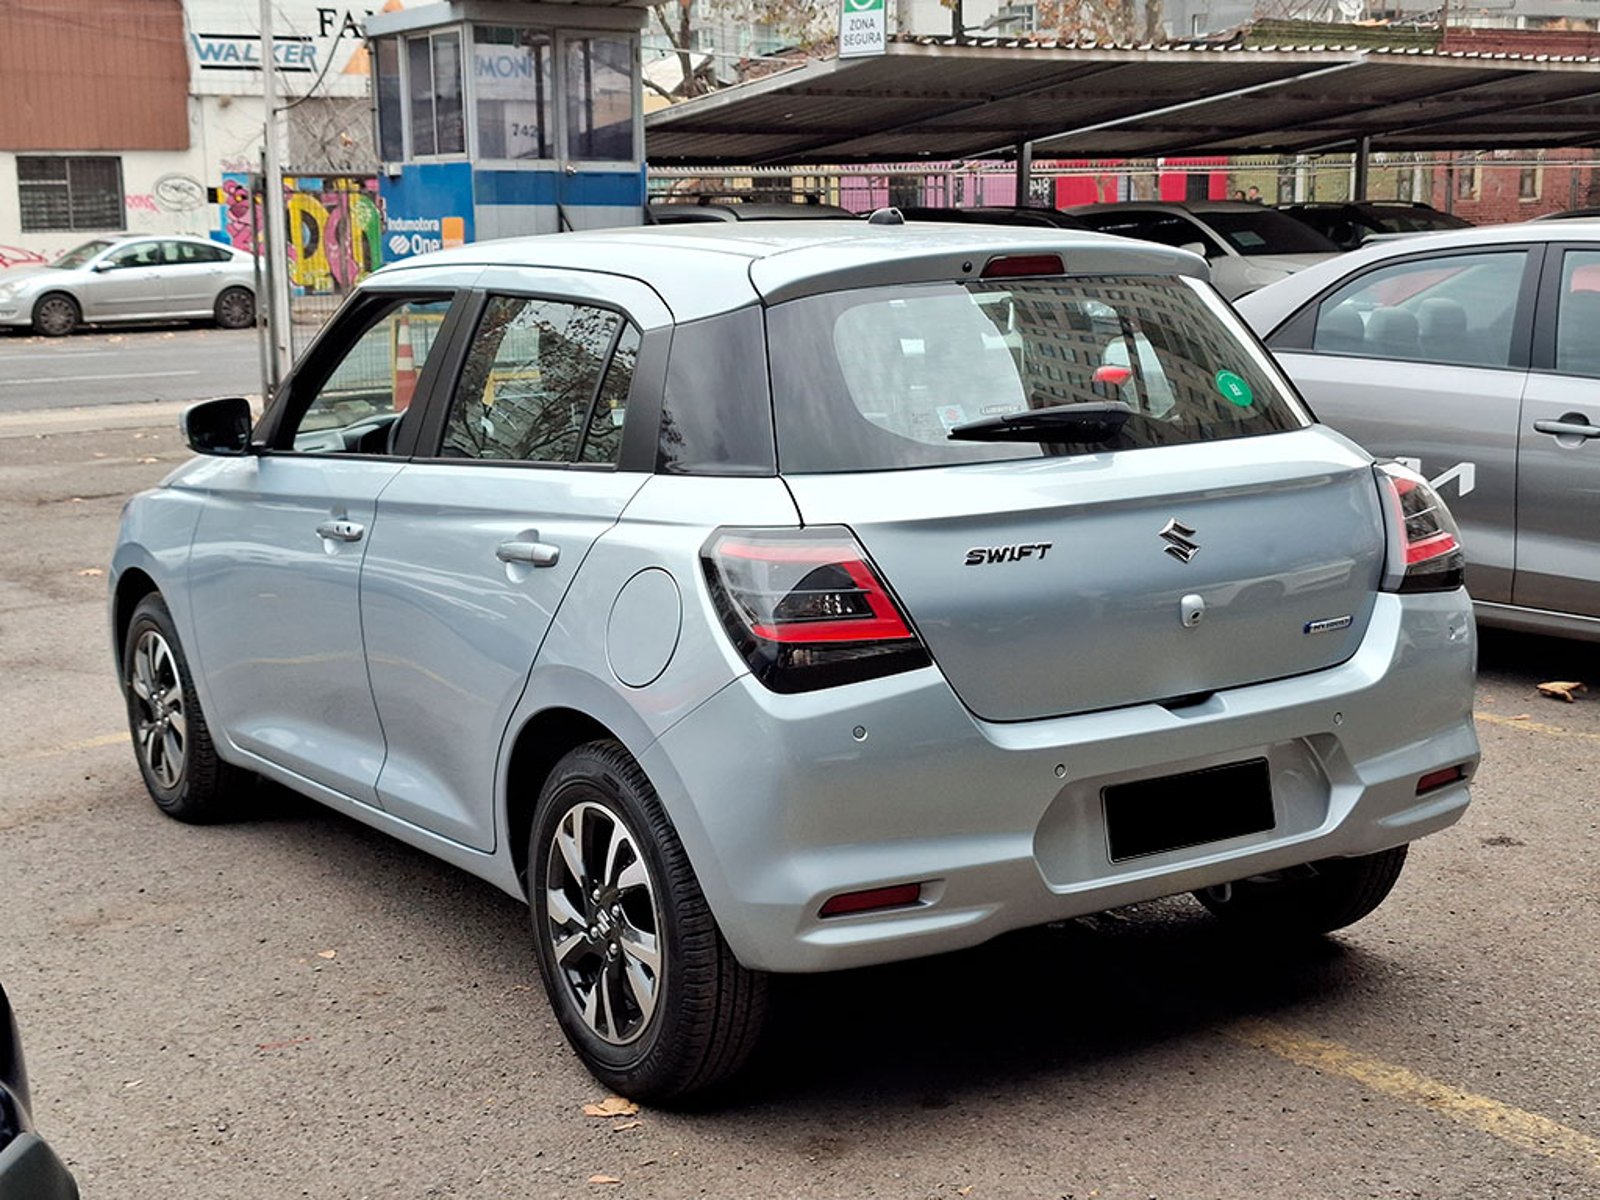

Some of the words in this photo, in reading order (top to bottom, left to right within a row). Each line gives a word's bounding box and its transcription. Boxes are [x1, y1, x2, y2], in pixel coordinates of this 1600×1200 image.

[317, 8, 373, 38] FA
[850, 17, 876, 31] ZONA
[844, 32, 882, 46] SEGURA
[387, 216, 440, 231] Indumotora
[411, 233, 440, 255] One
[963, 542, 1053, 566] SWIFT
